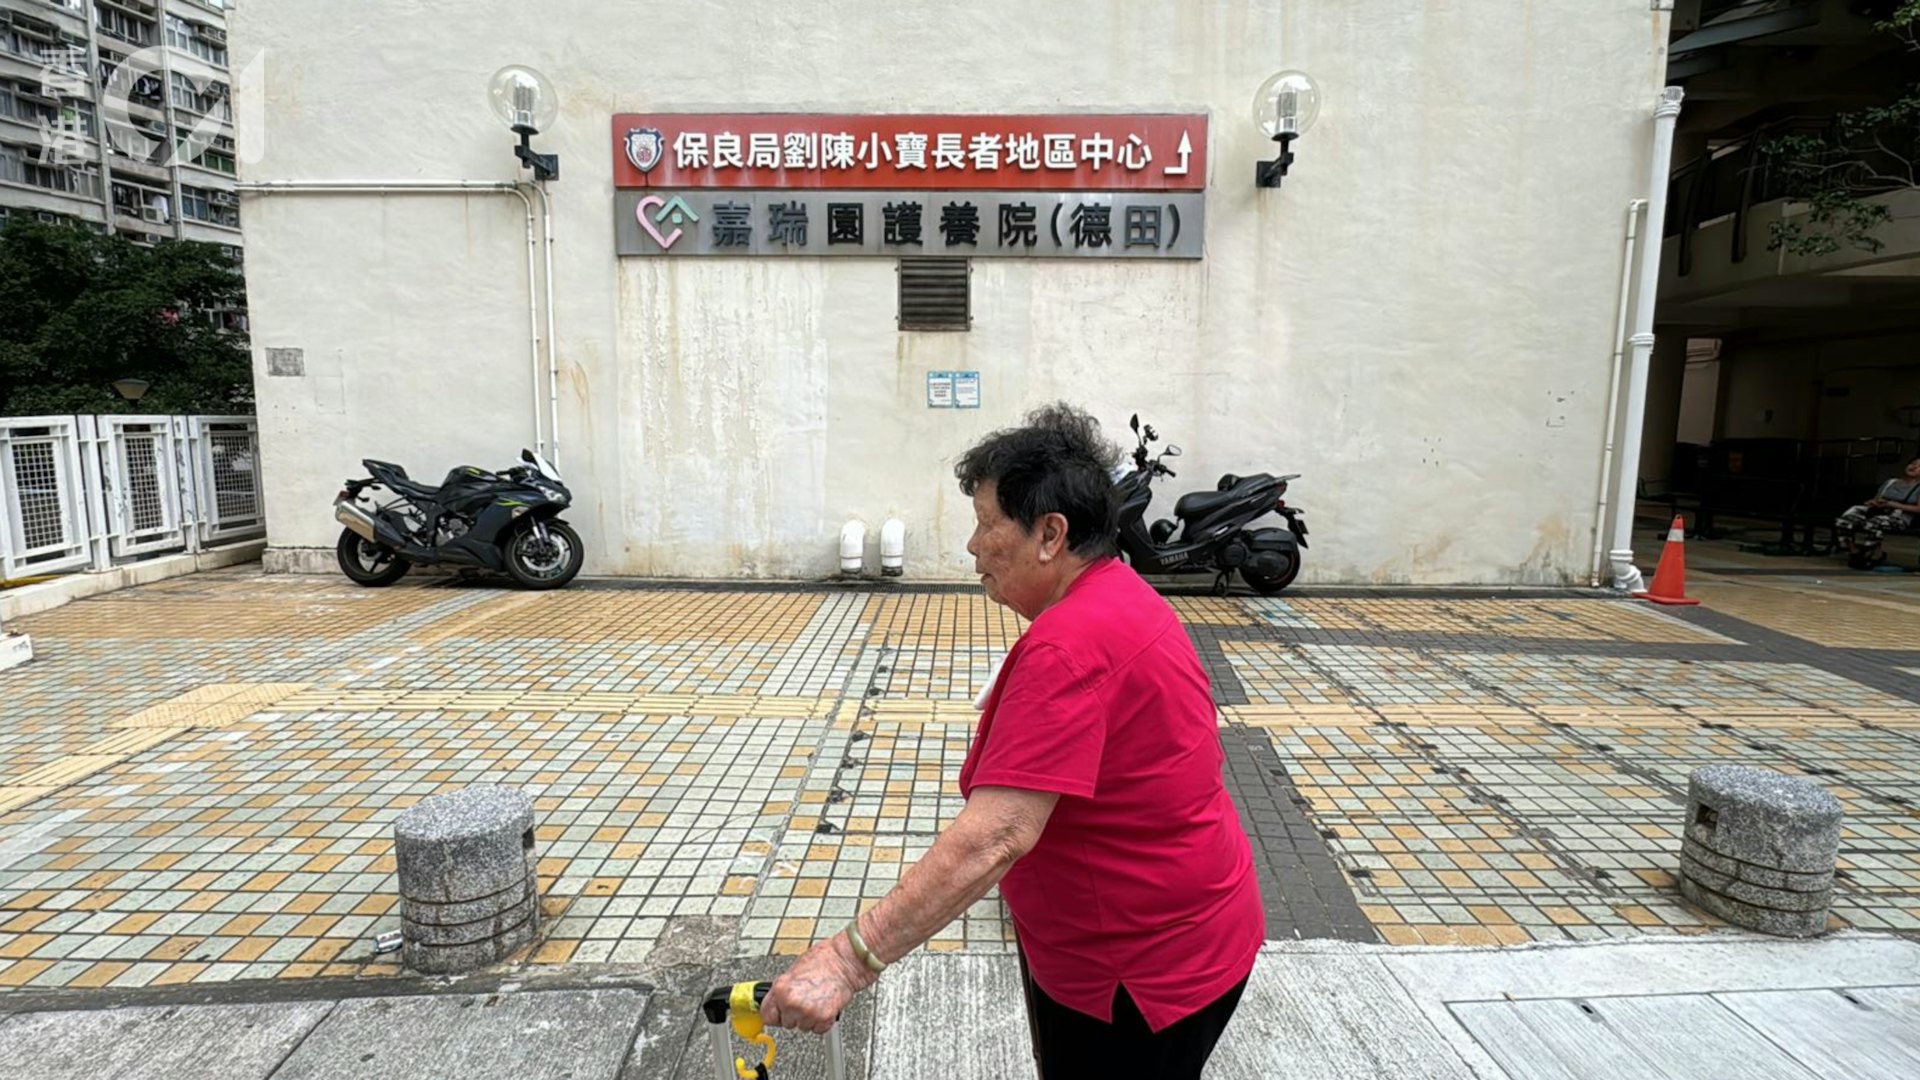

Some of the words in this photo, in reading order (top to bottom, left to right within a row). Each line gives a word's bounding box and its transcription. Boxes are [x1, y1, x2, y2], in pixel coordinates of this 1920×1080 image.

[673, 131, 1153, 170] 保良局劉陳小寶長者地區中心
[711, 201, 1181, 249] 嘉瑞園護養院(德田)
